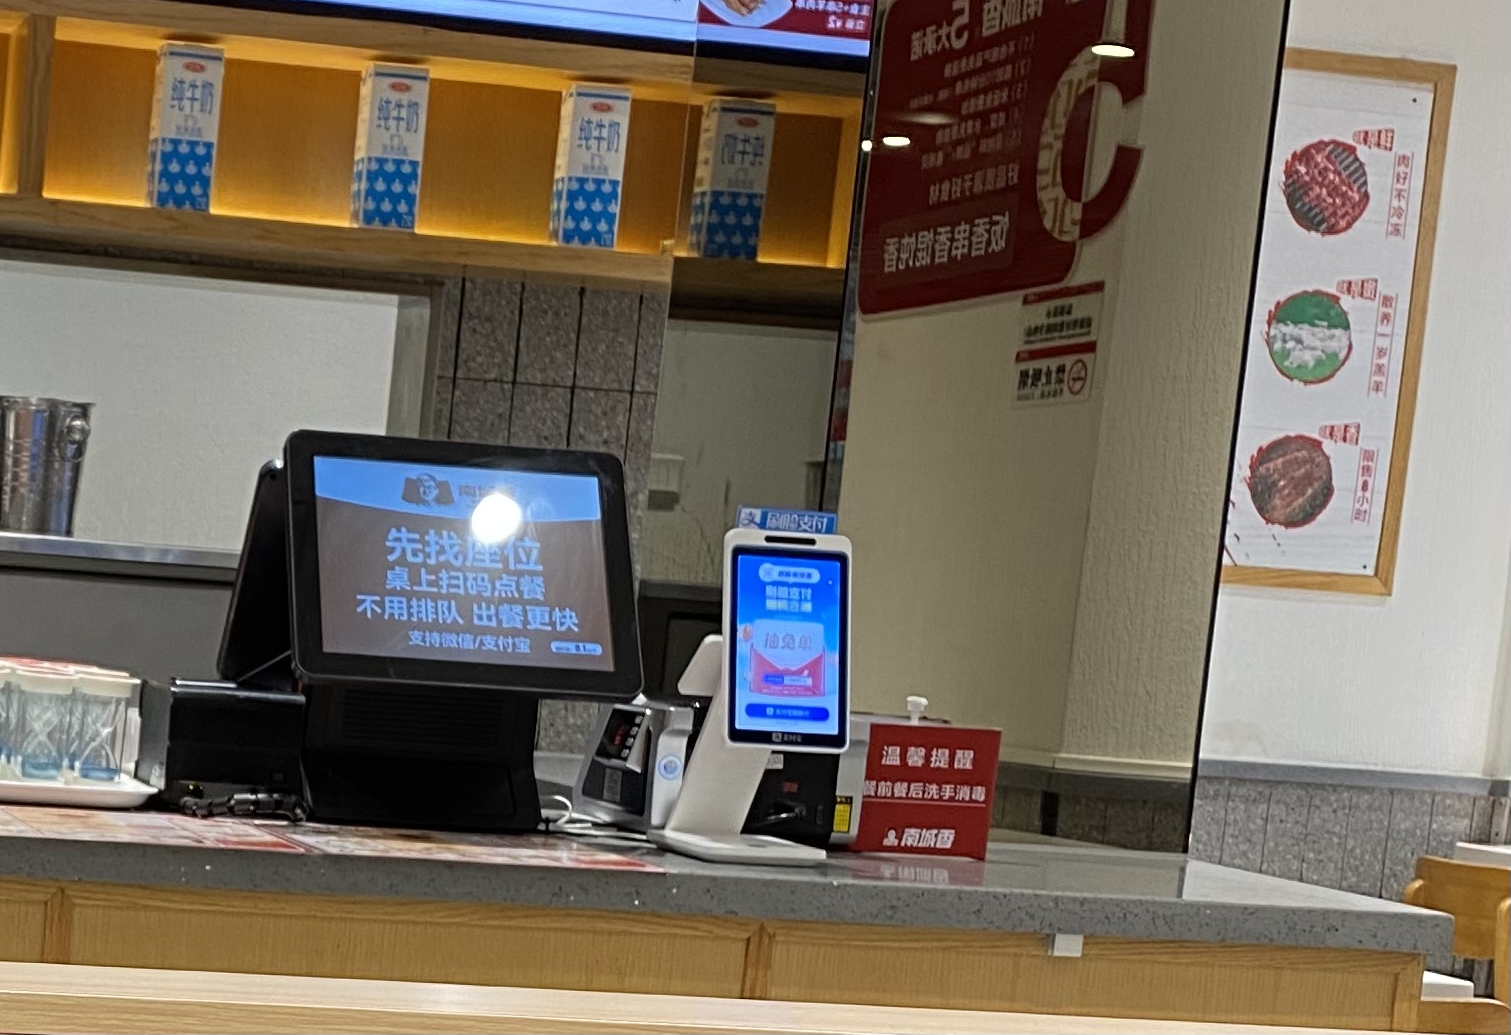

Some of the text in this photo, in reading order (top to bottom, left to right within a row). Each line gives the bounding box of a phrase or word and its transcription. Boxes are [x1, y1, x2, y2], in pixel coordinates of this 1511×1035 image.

[170, 77, 214, 116] 纯牛奶
[375, 96, 420, 135] 纯牛奶
[577, 116, 621, 153] 纯牛奶
[385, 568, 545, 601] 桌上扫码点餐
[356, 594, 579, 633] 不用排队 出餐更快
[408, 630, 531, 654] 支持微信/支付宝
[881, 745, 974, 769] 温馨提醒
[863, 780, 986, 801] 餐前餐后洗手消毒
[900, 827, 956, 848] 南城香
